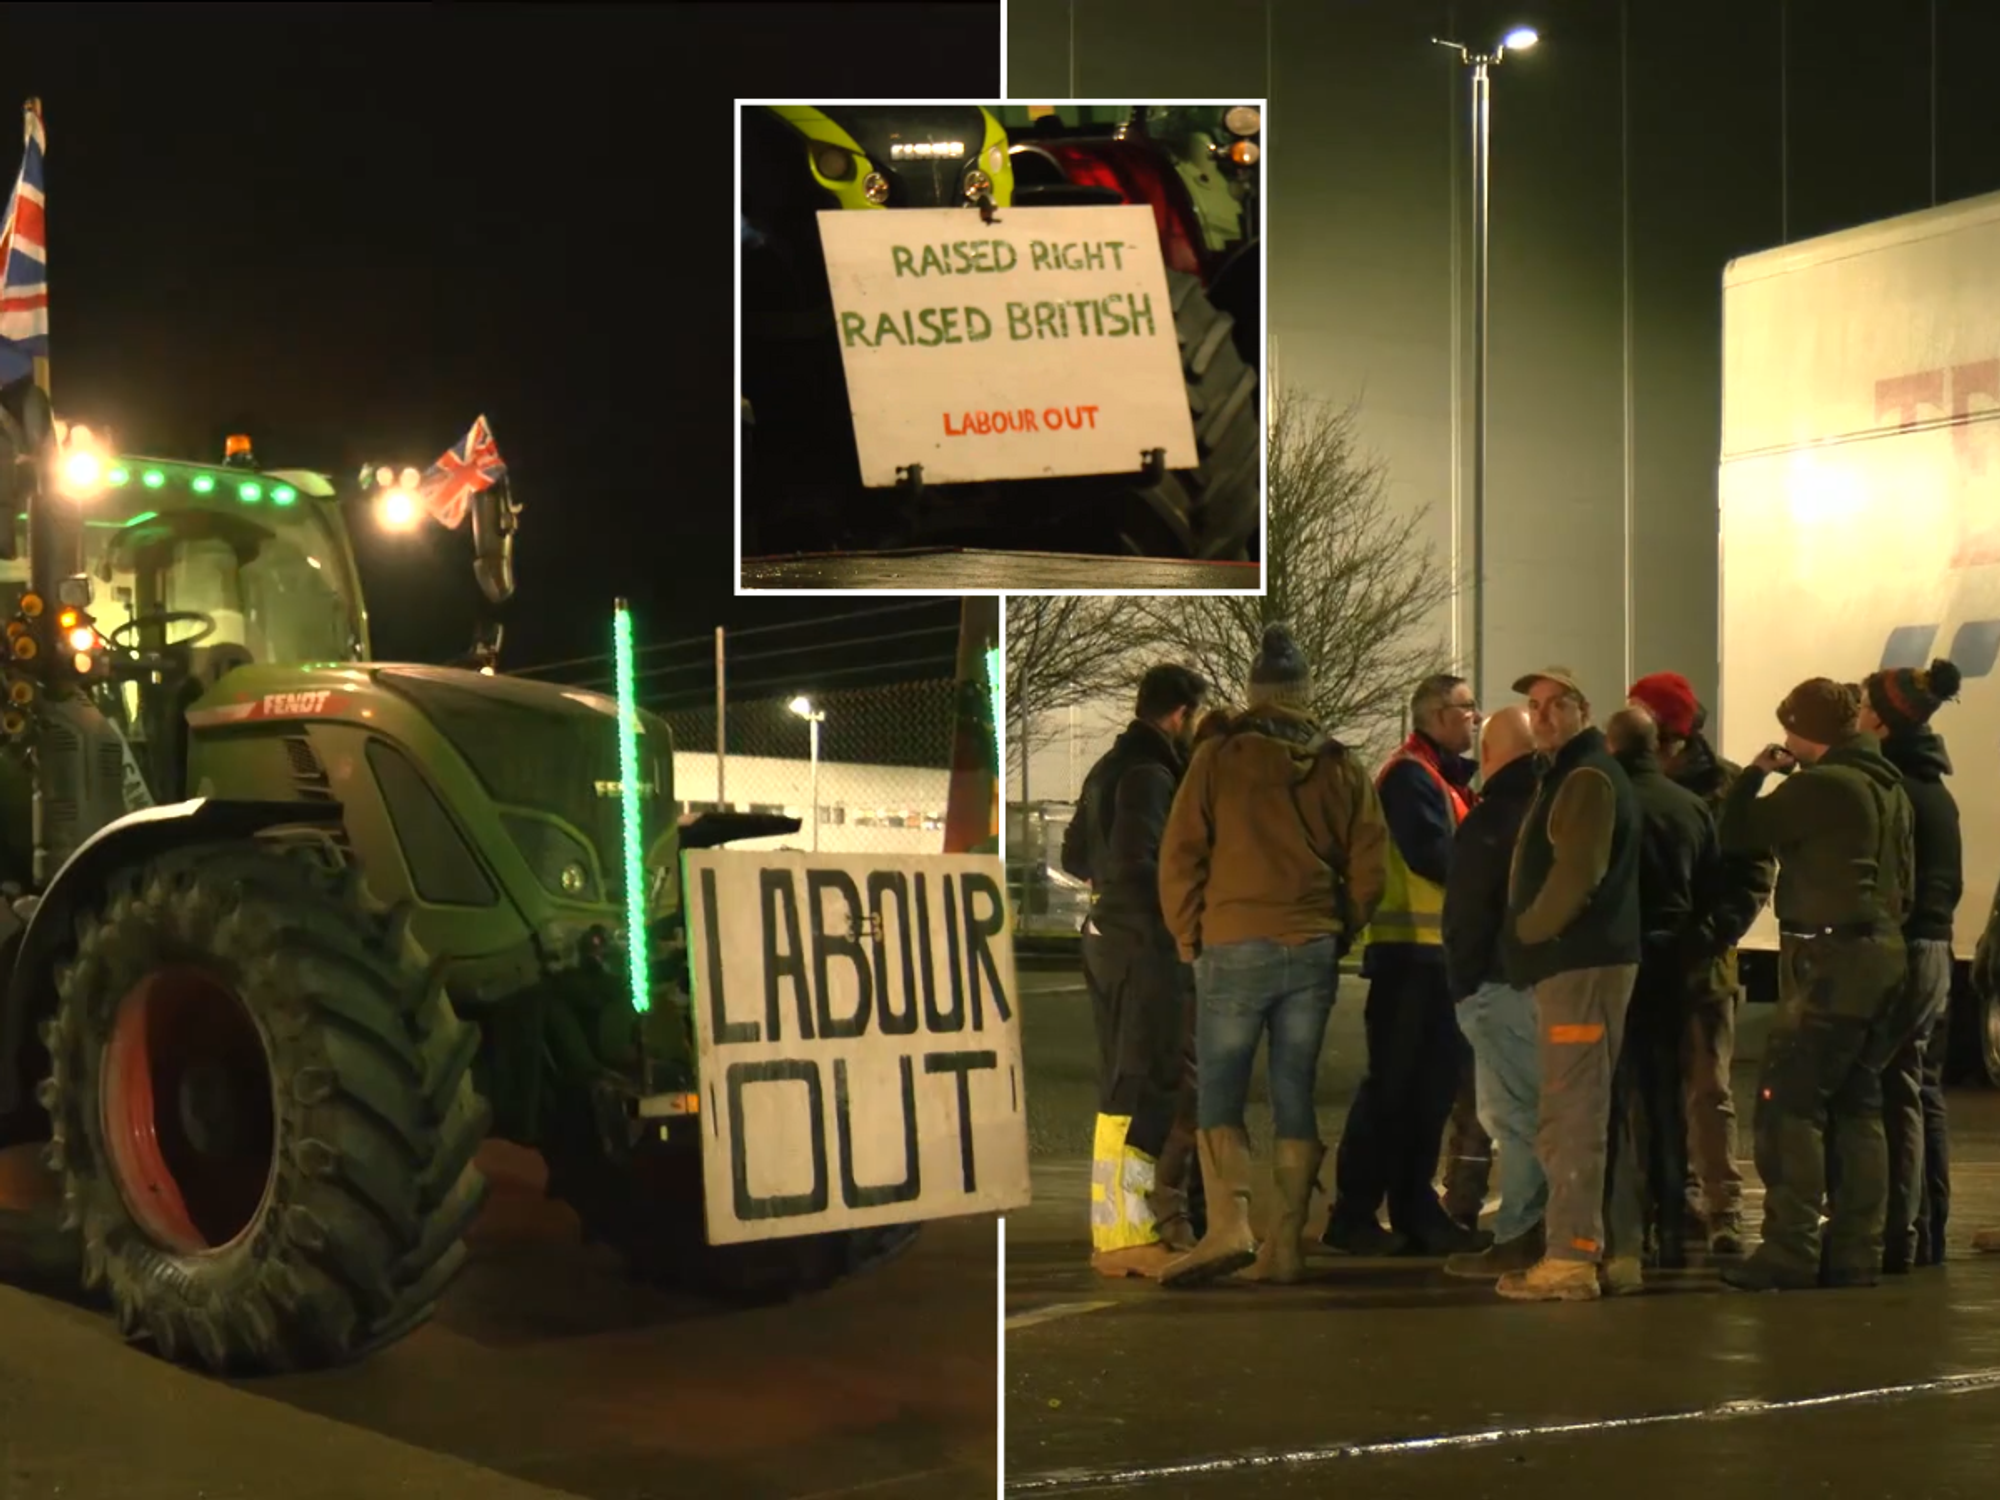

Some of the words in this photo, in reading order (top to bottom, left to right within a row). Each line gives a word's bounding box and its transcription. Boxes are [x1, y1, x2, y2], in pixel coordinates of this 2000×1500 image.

[891, 240, 1017, 277] RAISED
[1030, 240, 1124, 271] RIGHT
[840, 306, 992, 347] RAISED
[1006, 293, 1155, 341] BRITISH
[943, 408, 1039, 437] LABOUR
[1043, 405, 1099, 431] OUT
[263, 691, 331, 715] FENDT
[700, 867, 1011, 1045] LABOUR
[726, 1050, 997, 1221] OUT
